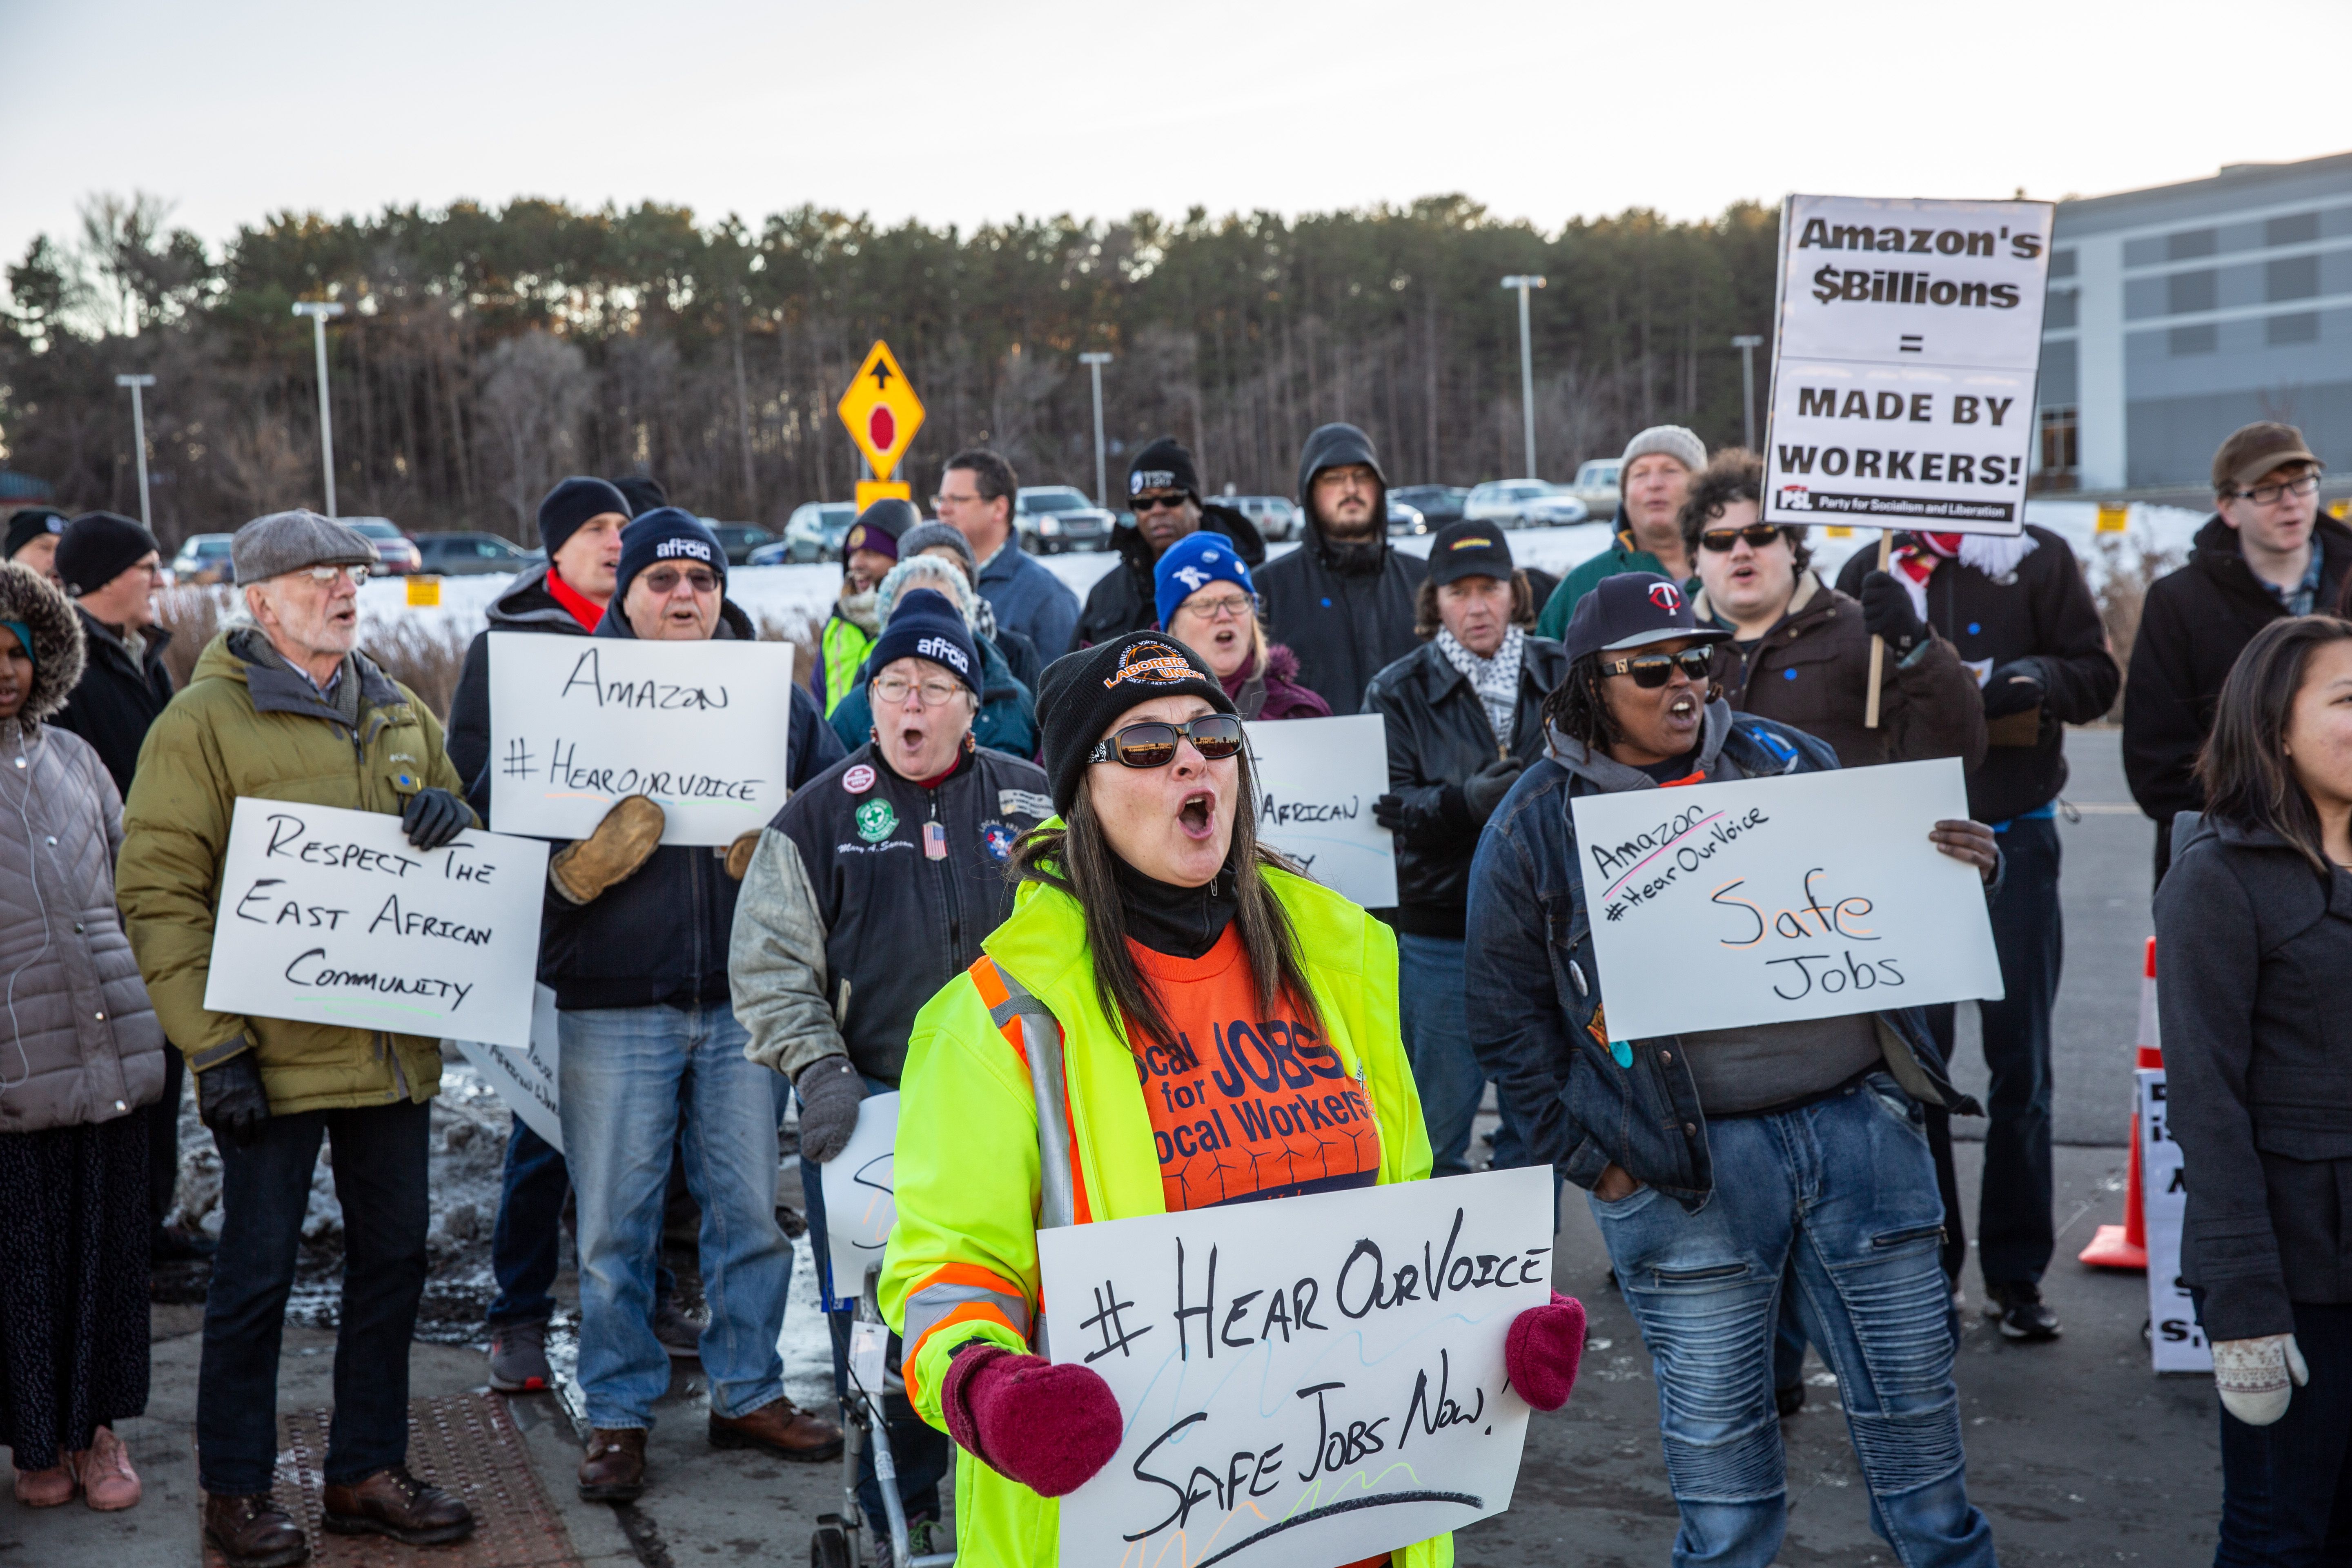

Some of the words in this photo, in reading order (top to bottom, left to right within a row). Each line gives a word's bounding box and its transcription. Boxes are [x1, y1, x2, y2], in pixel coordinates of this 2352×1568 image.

[1797, 217, 2043, 260] Amazon's
[1812, 264, 2021, 309] $Billions
[1798, 387, 1933, 423] MADE
[1952, 394, 2014, 427] BY
[1777, 444, 2022, 486] WORKERS!
[1780, 491, 1813, 510] PSL
[1819, 496, 1849, 511] Party
[1852, 497, 1869, 510] for
[1870, 499, 1923, 514] Socialism
[1925, 502, 1947, 515] and
[1948, 503, 2005, 518] Liberation
[562, 648, 728, 710] AMAZON
[1103, 657, 1189, 689] LABORERS
[1158, 668, 1206, 681] UNION
[1261, 793, 1359, 826] AFRICAN
[267, 815, 421, 877] RESPECT
[437, 842, 495, 885] THE
[1591, 805, 1703, 879] Amazon
[236, 879, 349, 930] EAST
[369, 894, 492, 945] AFRICAN
[1712, 868, 1881, 944] Safe
[285, 948, 472, 1011] COMMUNITY
[1766, 951, 1904, 1000] Jobs
[1211, 1020, 1345, 1098] JOBS
[1161, 1079, 1205, 1113] for
[1154, 1109, 1231, 1164] ocal
[1230, 1090, 1369, 1142] Workers
[1123, 1412, 1283, 1542] SAFE
[1296, 1382, 1390, 1482] JOBS
